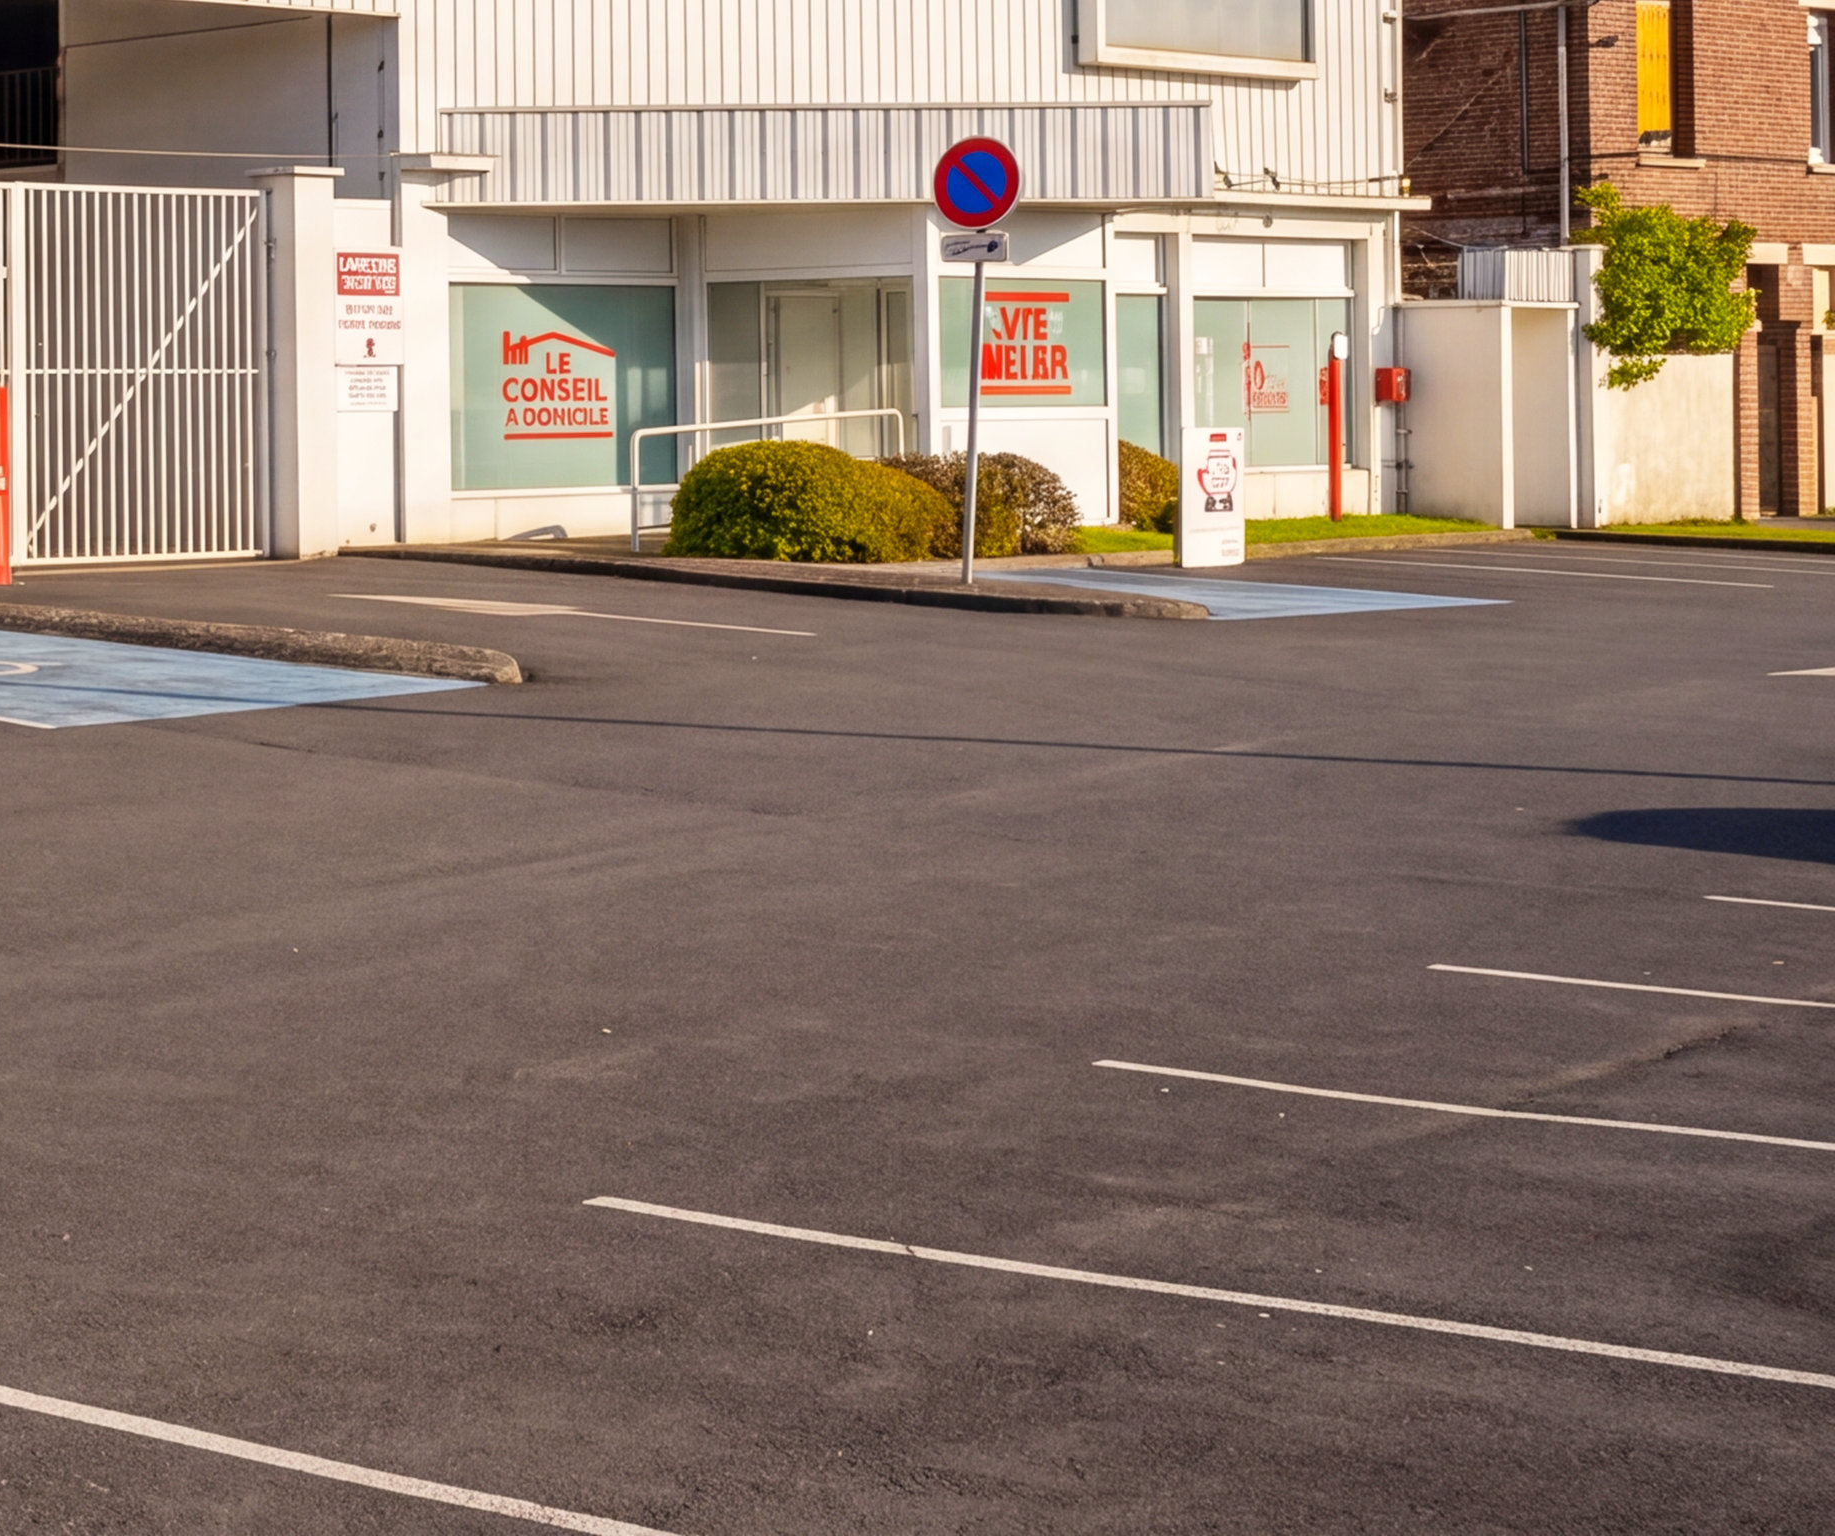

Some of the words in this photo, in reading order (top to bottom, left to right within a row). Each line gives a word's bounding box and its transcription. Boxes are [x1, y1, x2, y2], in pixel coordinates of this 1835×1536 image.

[545, 351, 572, 375] LE
[501, 377, 609, 403] CONSEIL
[505, 407, 520, 427] A
